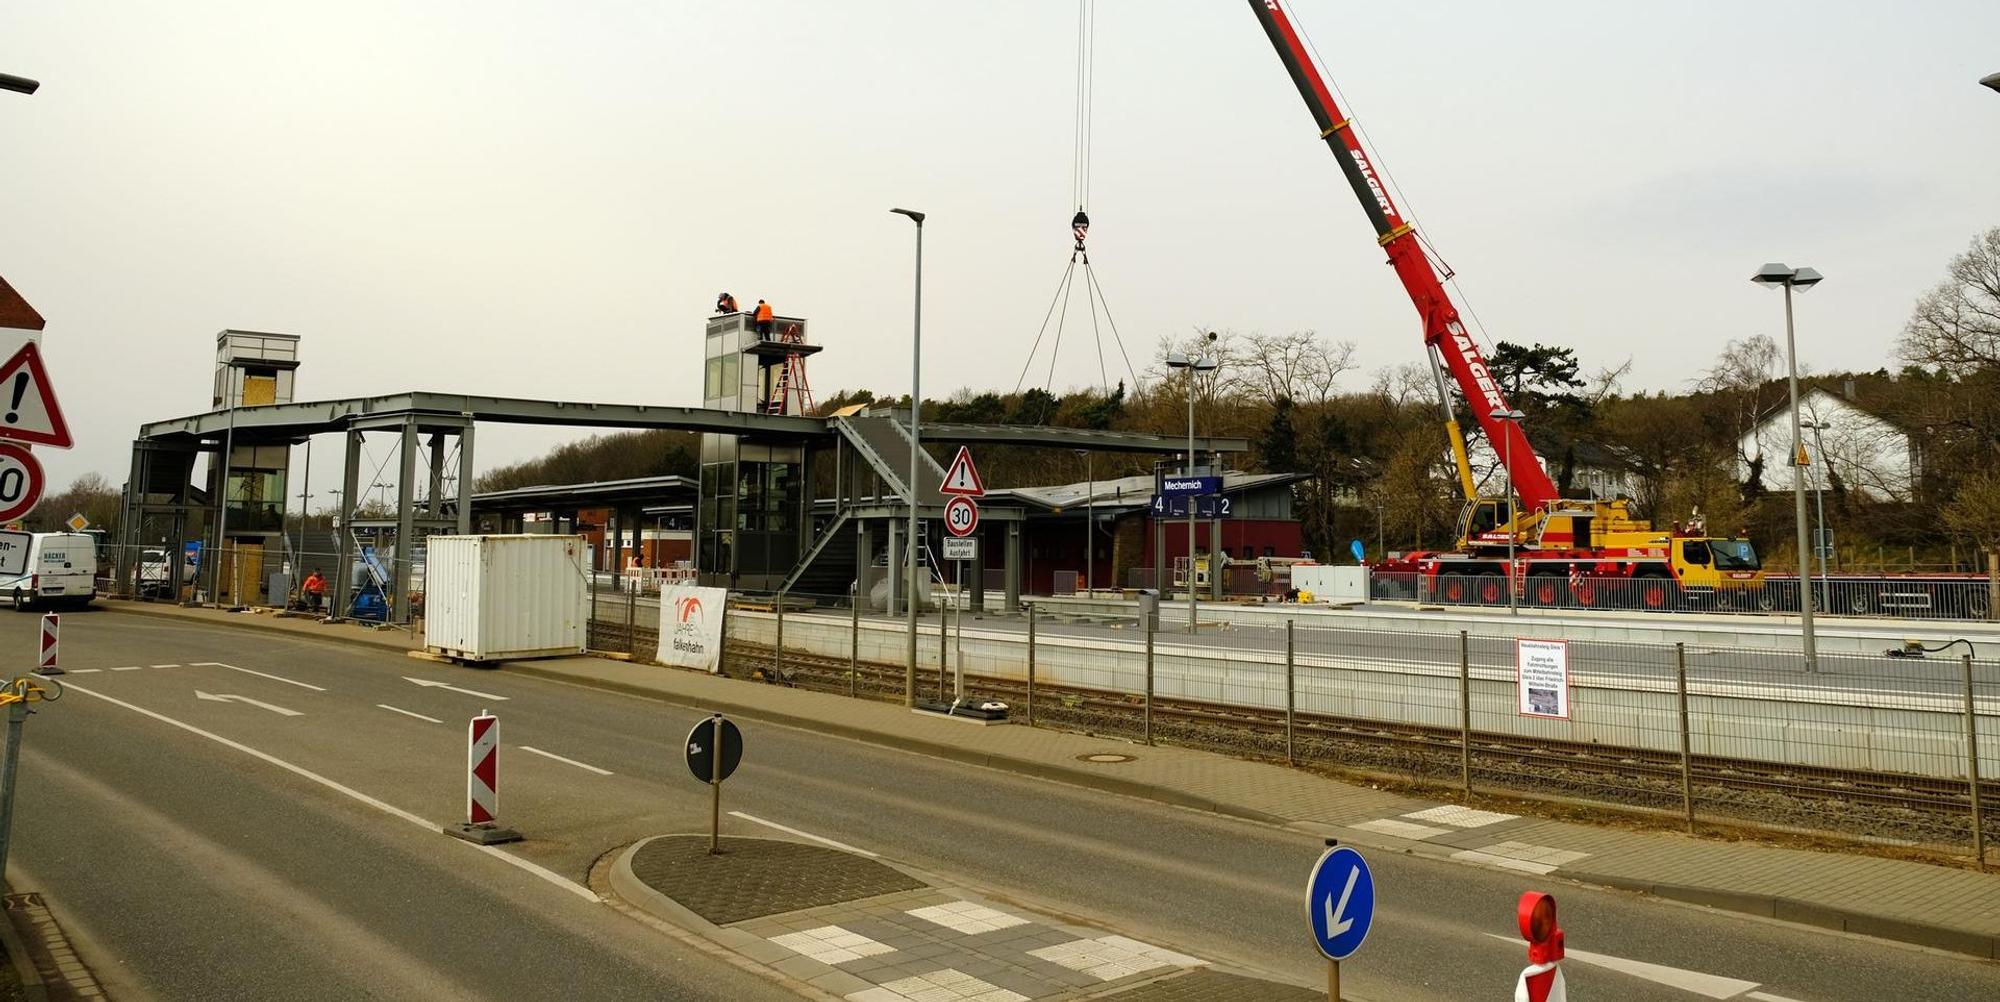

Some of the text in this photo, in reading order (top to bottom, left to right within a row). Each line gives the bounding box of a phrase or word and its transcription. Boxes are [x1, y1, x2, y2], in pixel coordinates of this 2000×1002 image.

[1350, 149, 1396, 216] SALGERT
[0, 458, 24, 502] 0
[1164, 480, 1203, 490] Mechernich
[1155, 496, 1164, 512] 4
[1221, 498, 1230, 514] 2
[953, 507, 970, 525] 30
